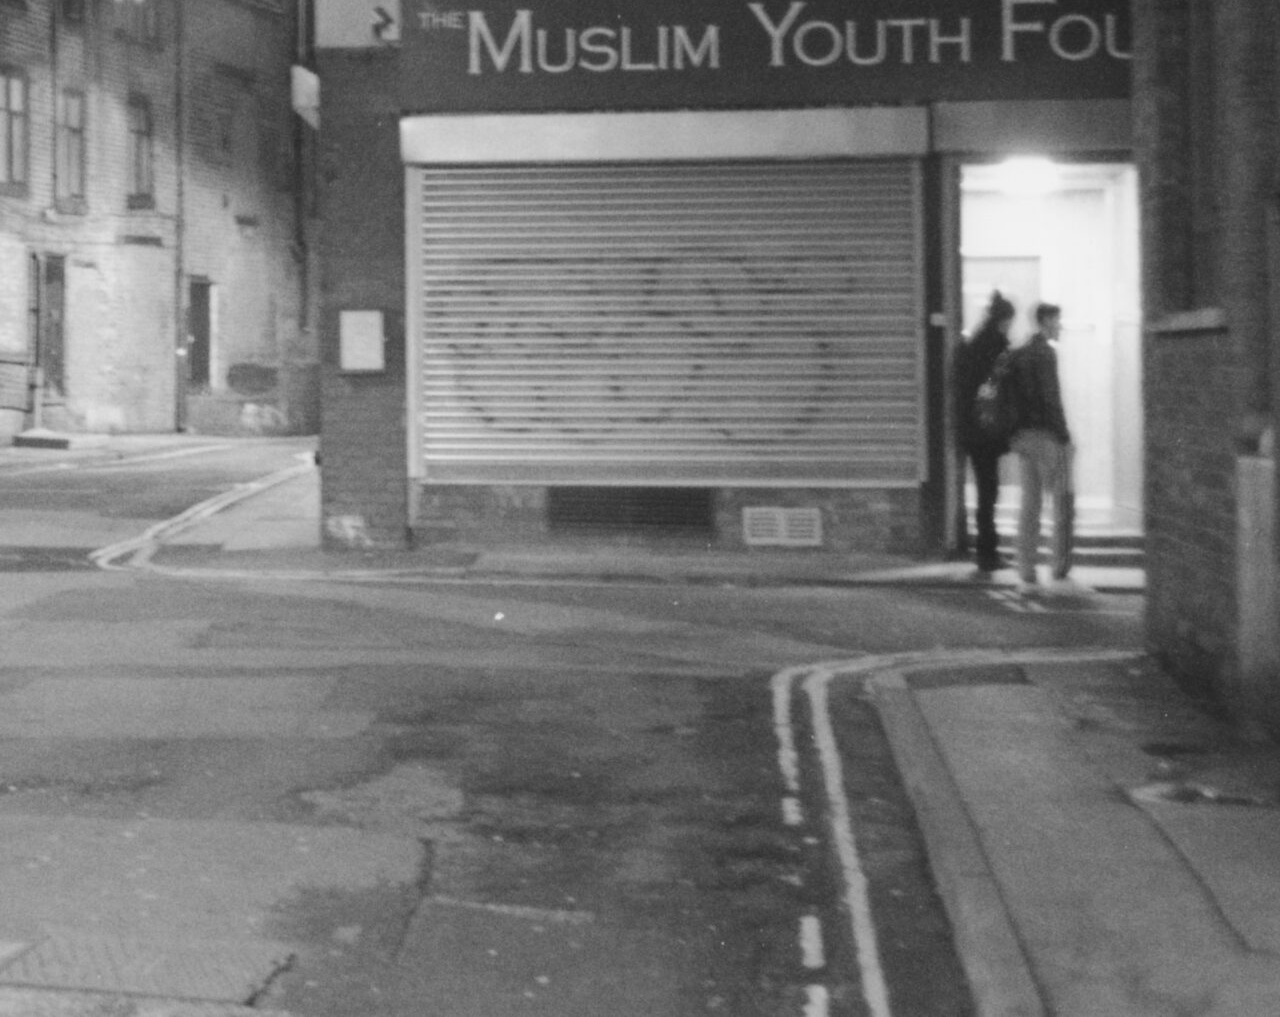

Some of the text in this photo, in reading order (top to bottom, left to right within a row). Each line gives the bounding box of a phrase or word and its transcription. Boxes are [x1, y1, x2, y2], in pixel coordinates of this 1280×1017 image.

[418, 11, 465, 29] THE
[467, 8, 720, 74] MUSLIM
[746, 0, 971, 67] YOUTH
